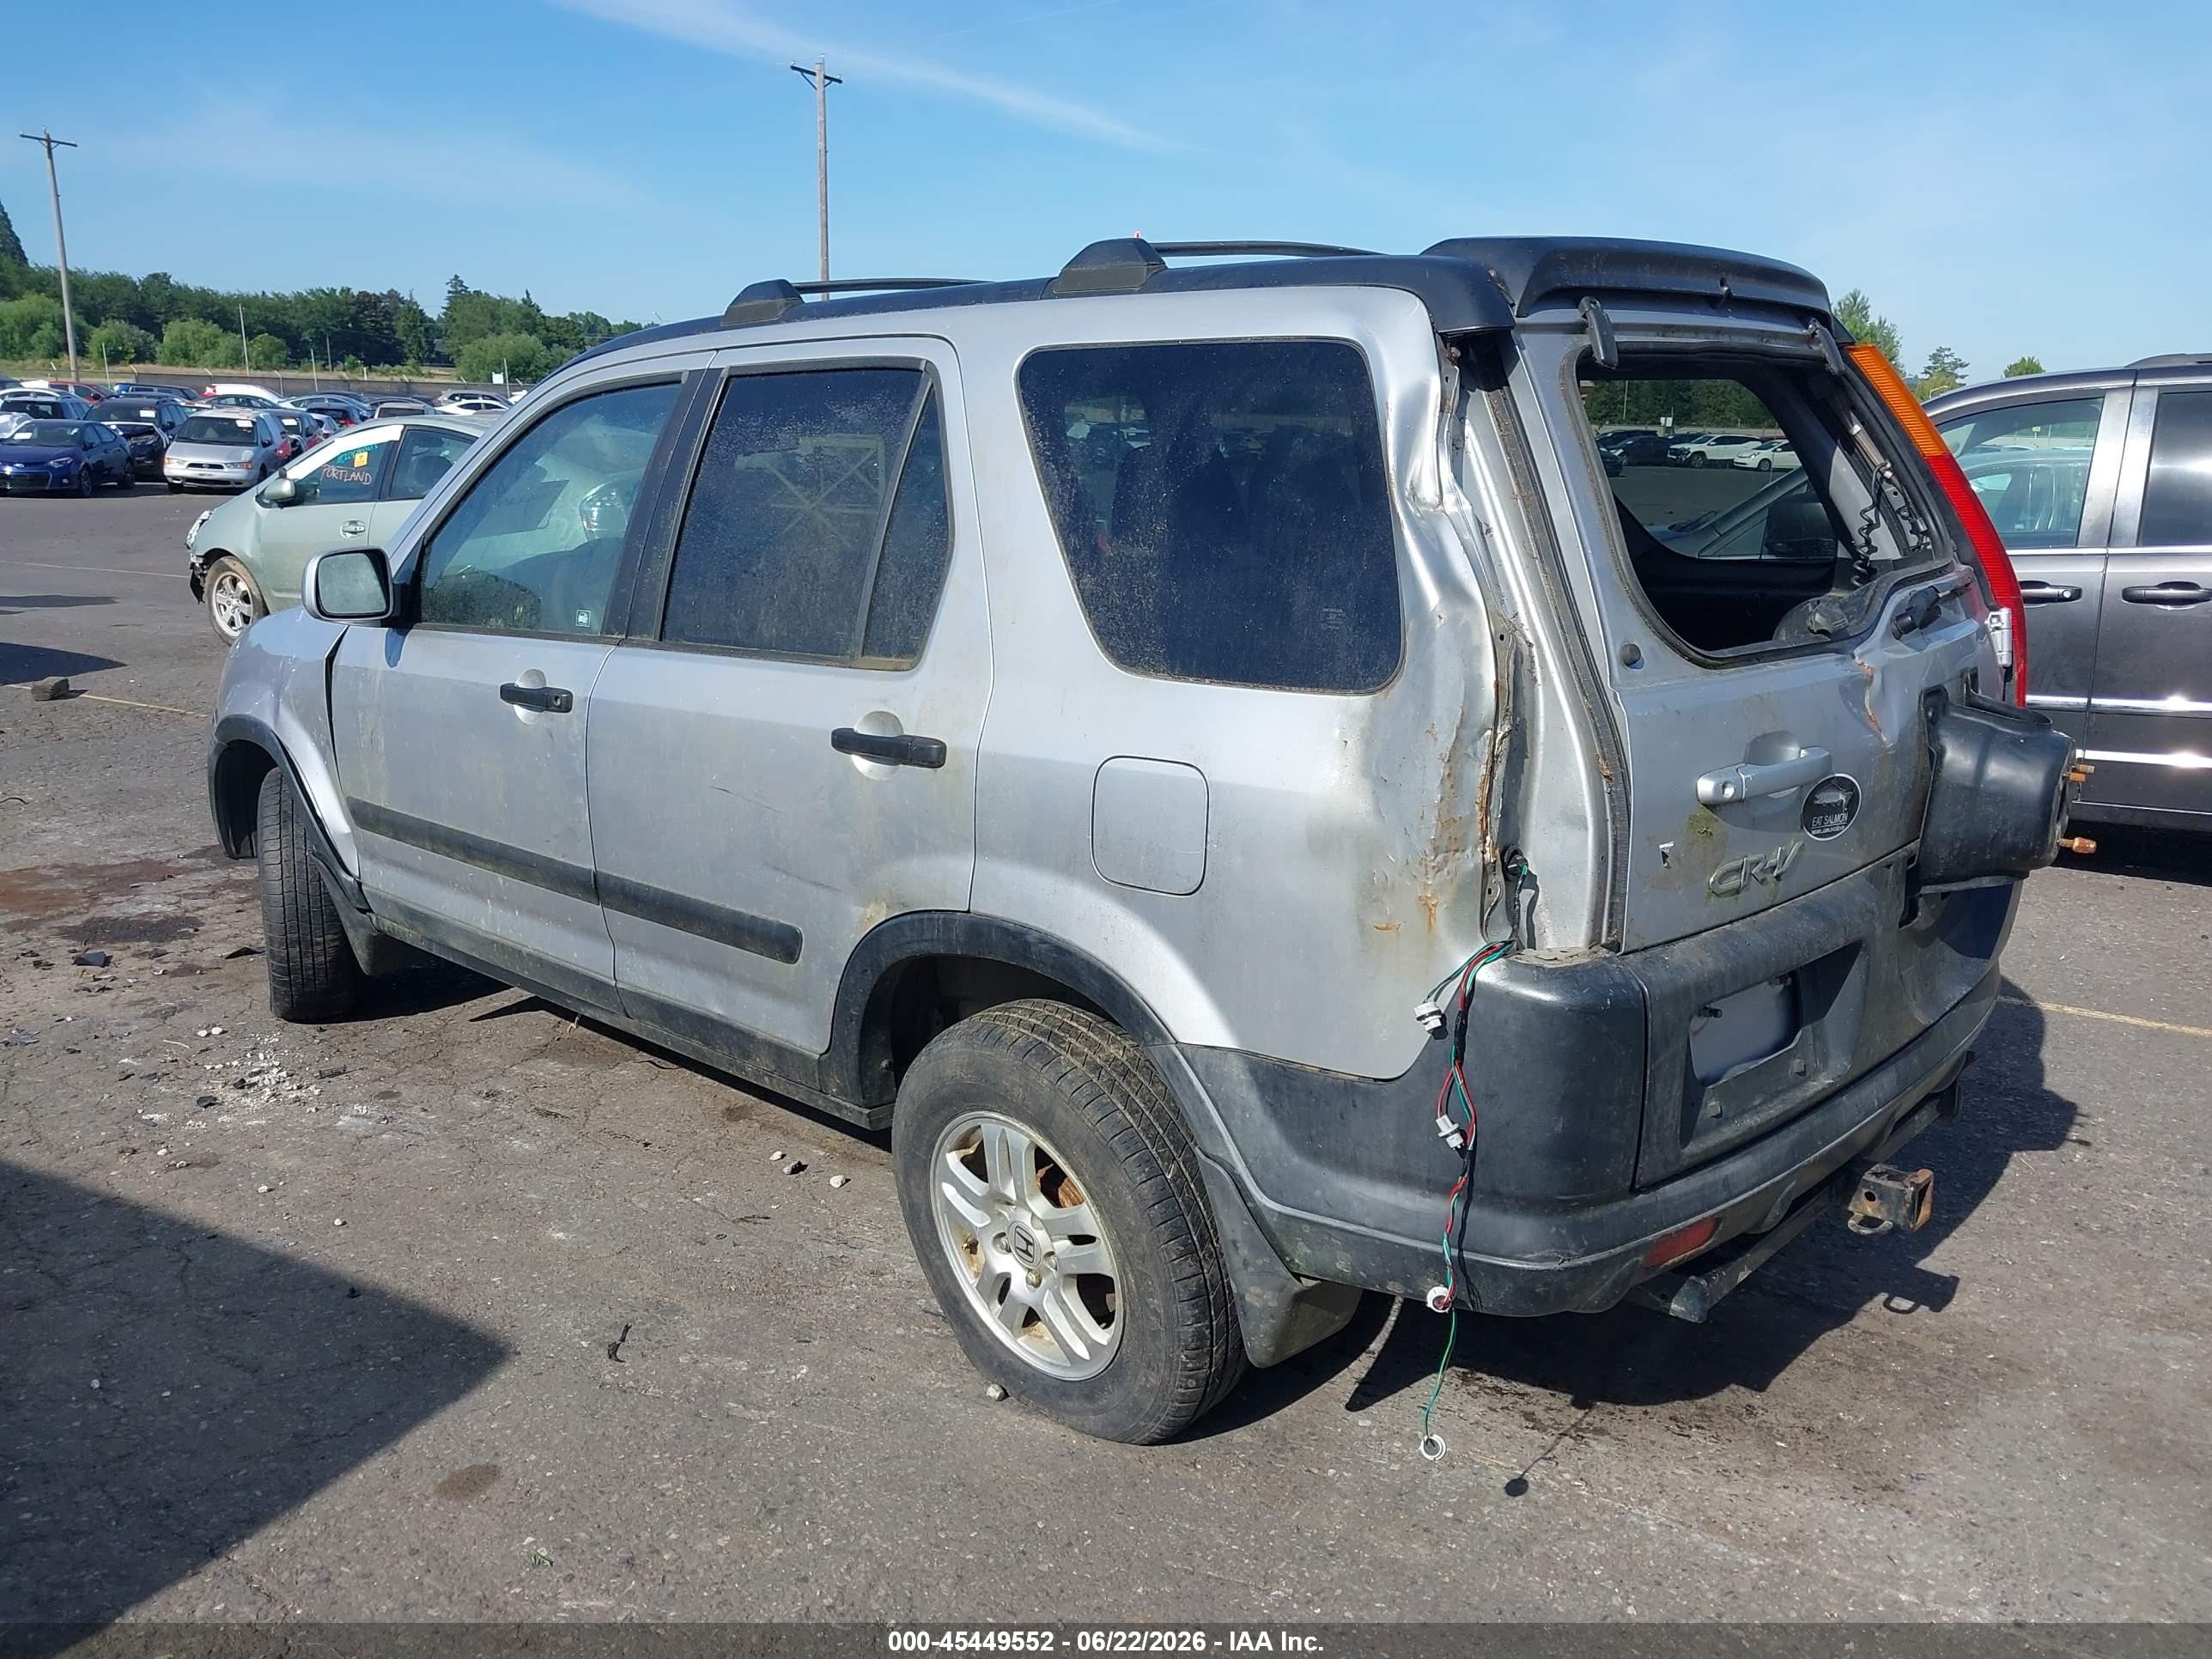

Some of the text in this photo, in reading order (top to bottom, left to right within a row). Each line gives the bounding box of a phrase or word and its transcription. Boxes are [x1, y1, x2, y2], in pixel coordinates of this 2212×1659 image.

[320, 465, 372, 485] PORTLAND
[1812, 811, 1849, 827] EAT SALMON
